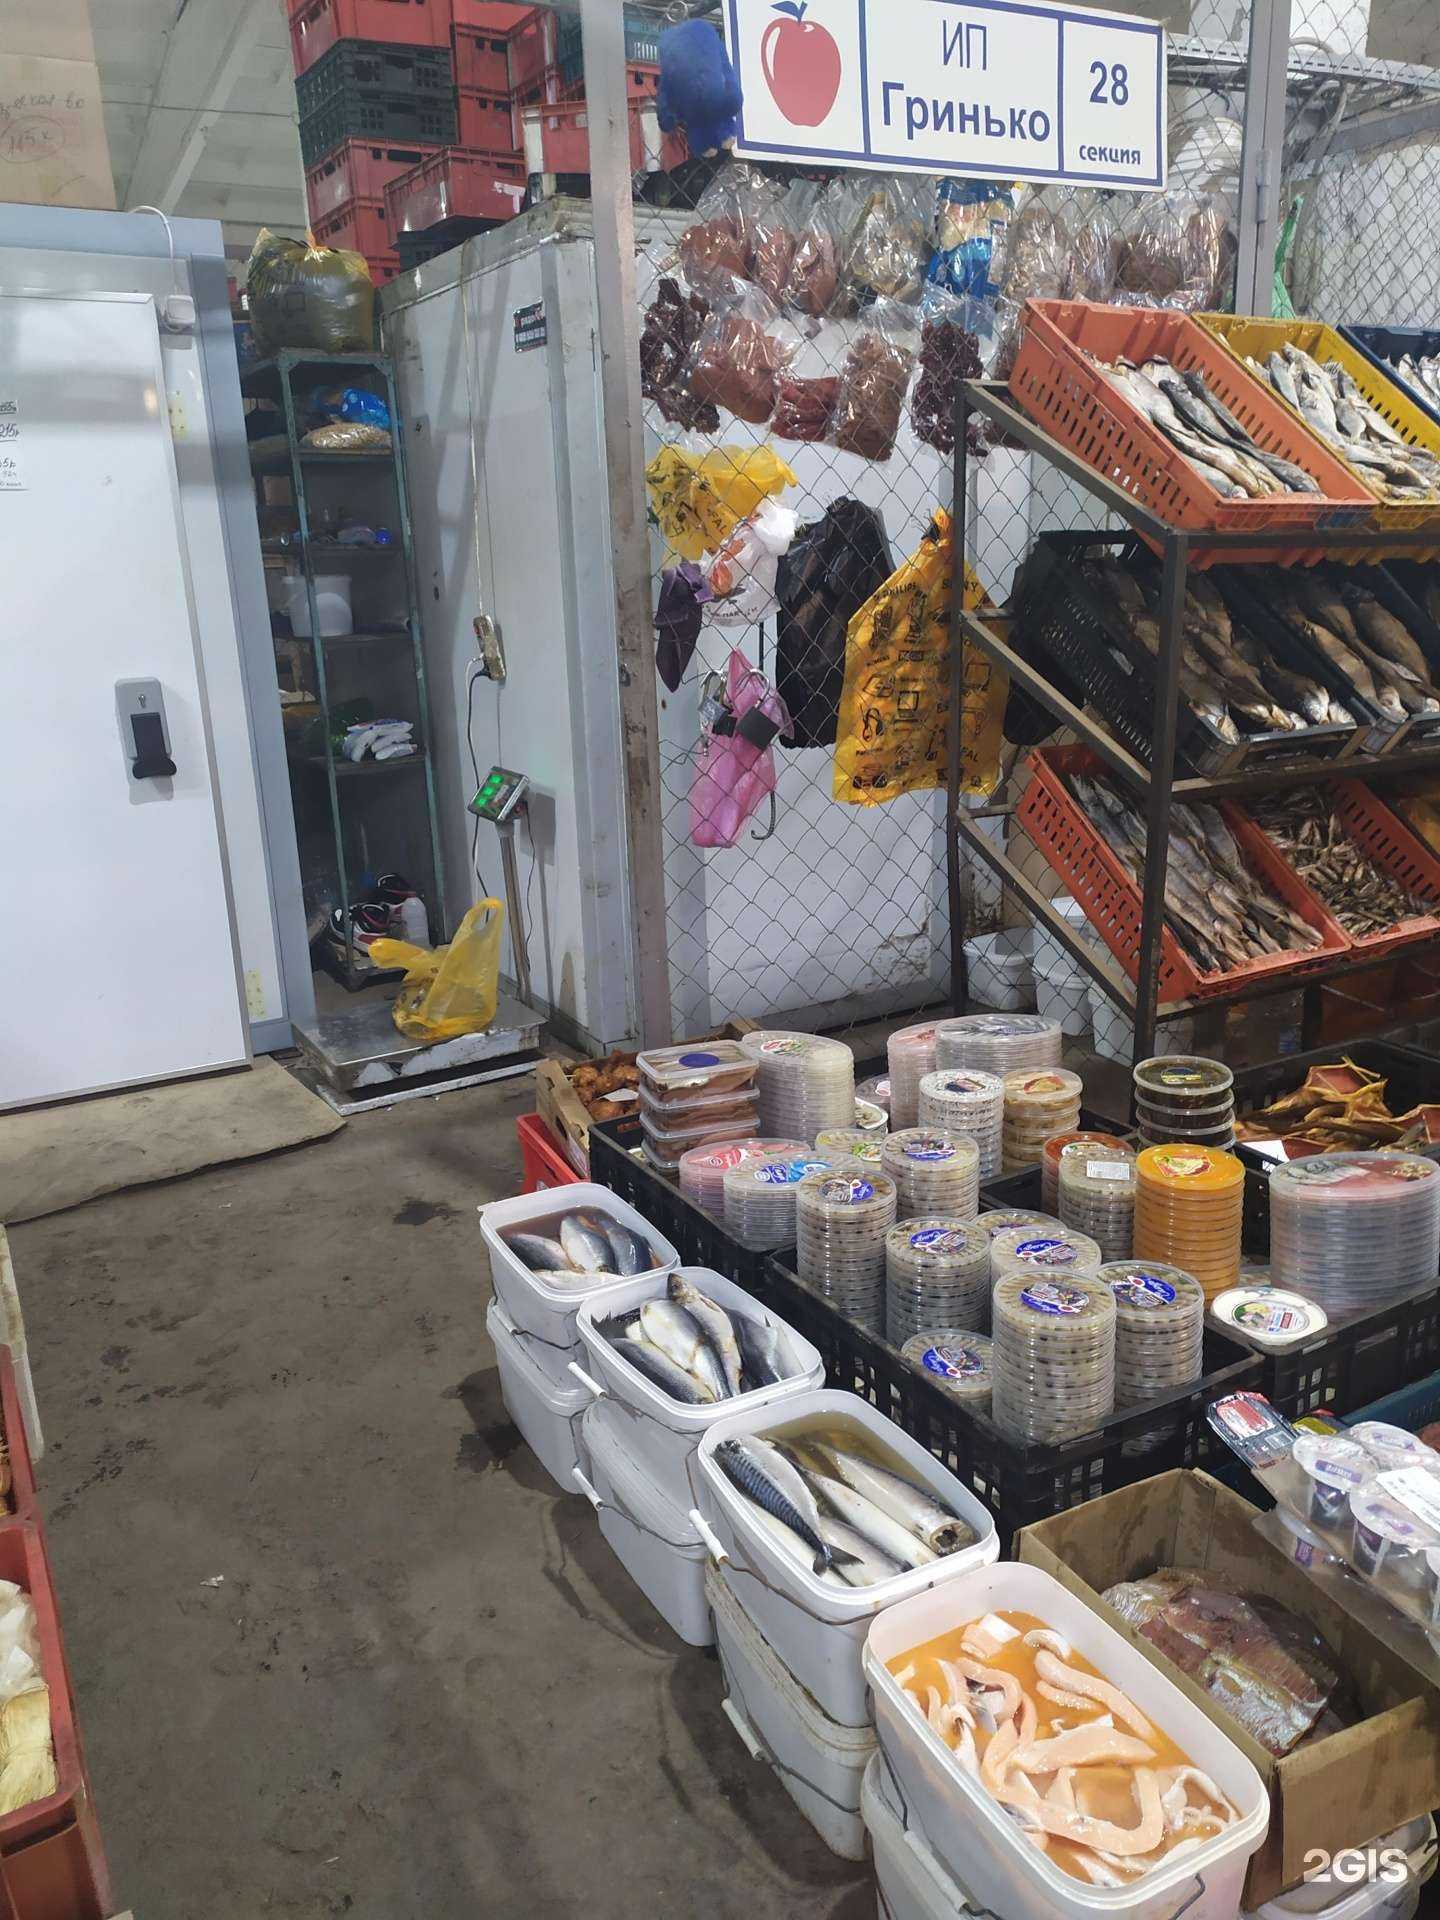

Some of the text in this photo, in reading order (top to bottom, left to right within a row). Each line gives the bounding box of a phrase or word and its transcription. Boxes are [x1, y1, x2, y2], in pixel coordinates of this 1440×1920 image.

[942, 19, 987, 71] ИП
[1089, 61, 1129, 106] 28
[882, 81, 1051, 142] Гринько
[1078, 144, 1141, 165] секция
[942, 578, 979, 593] SNY
